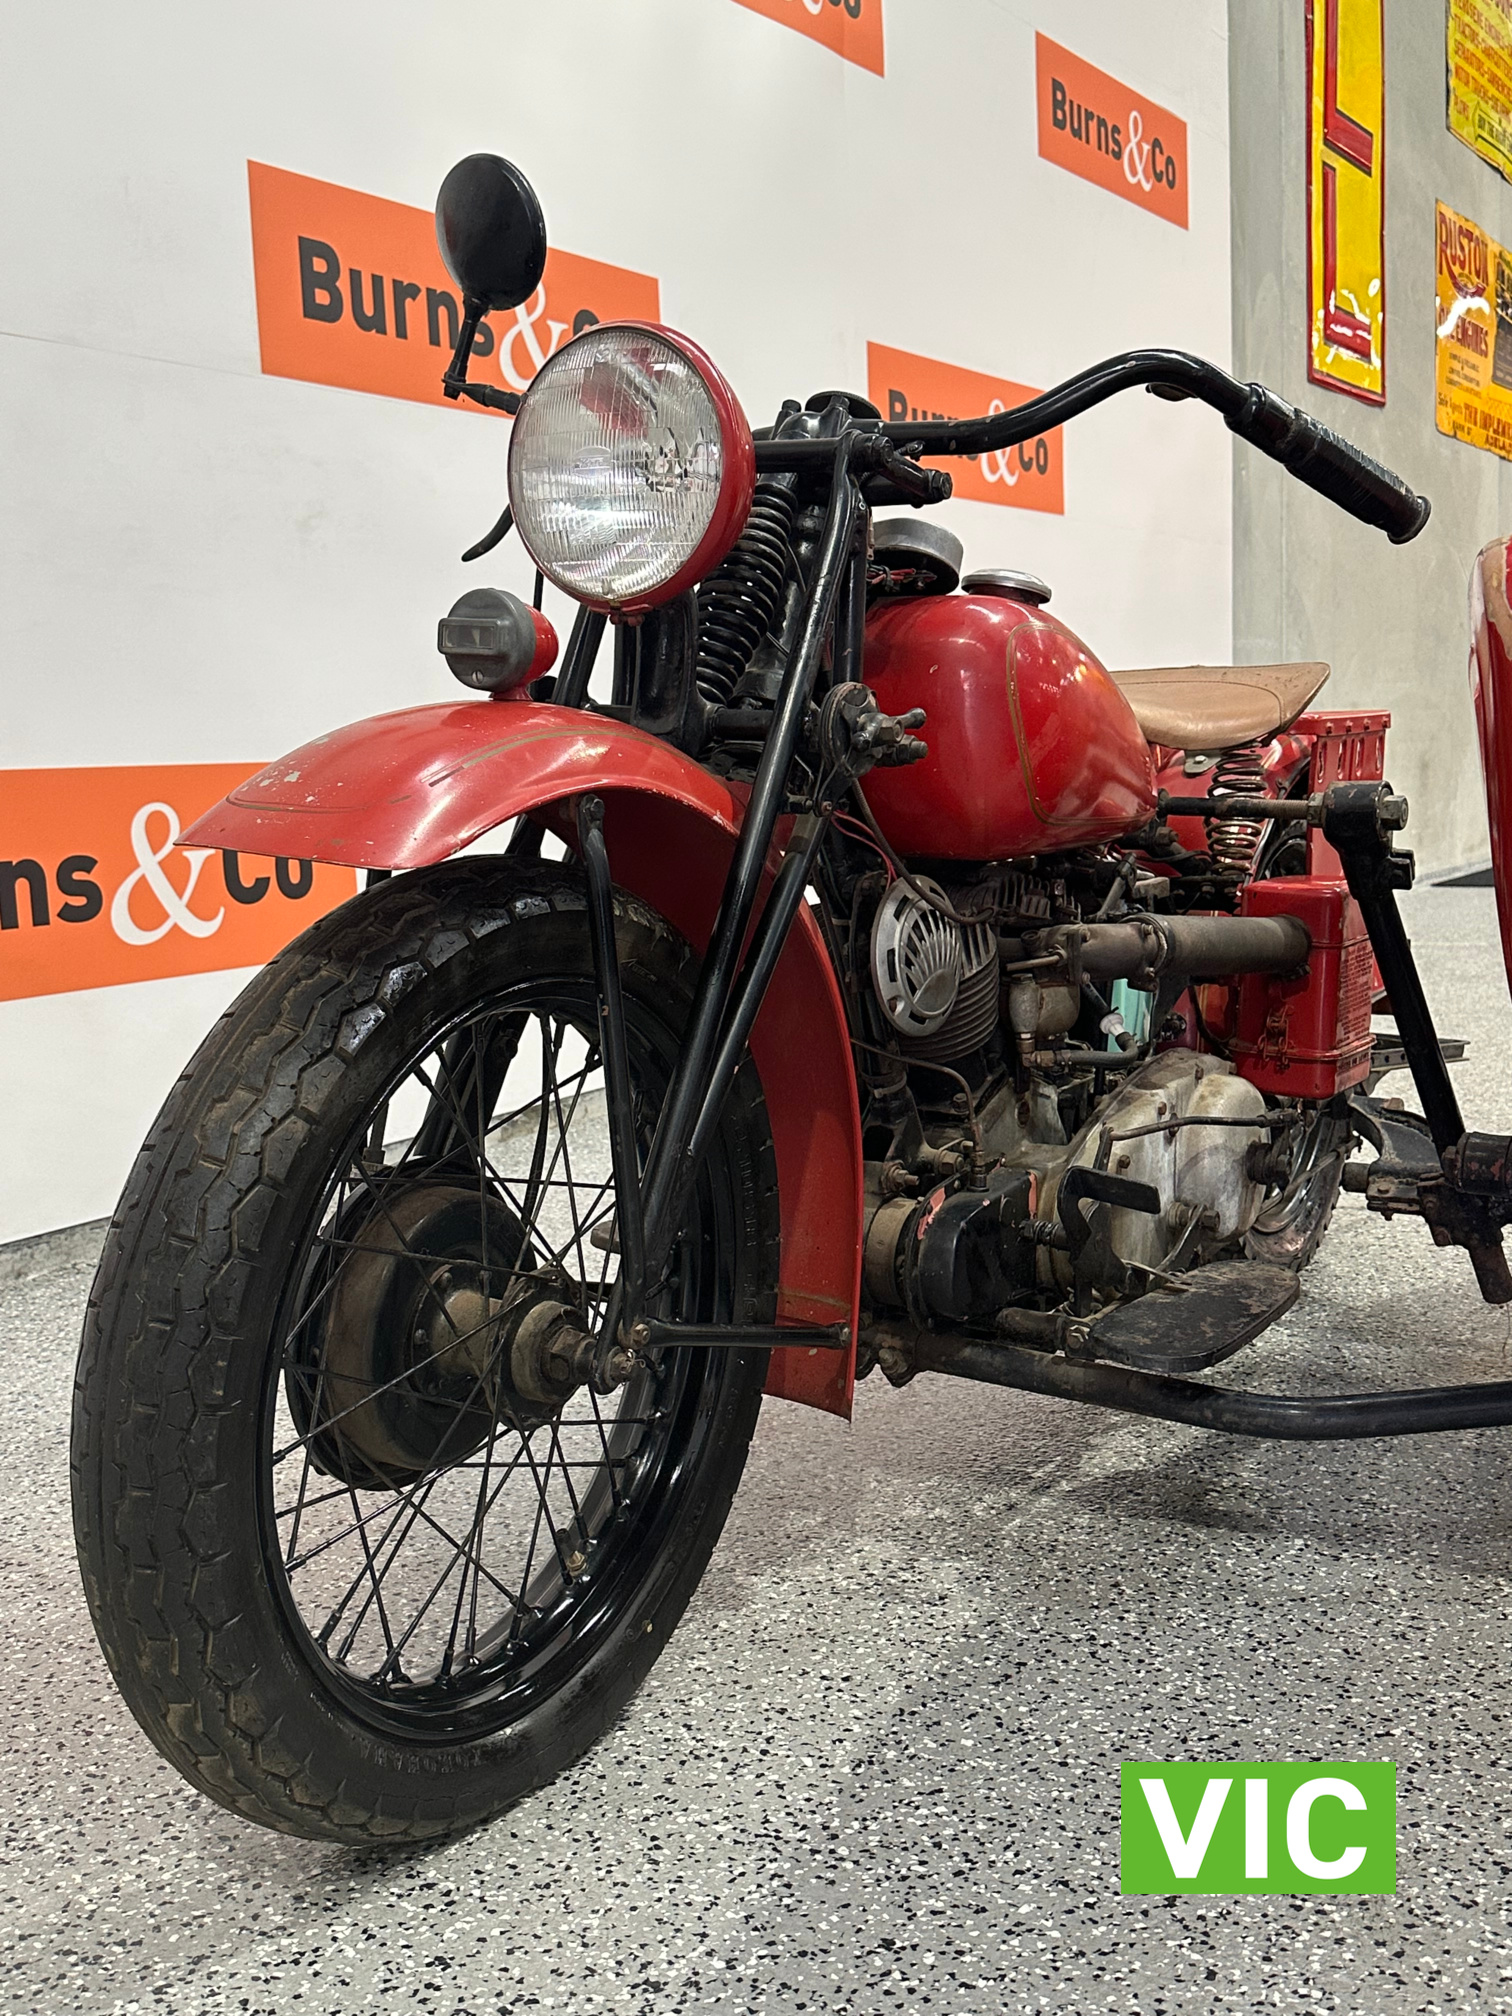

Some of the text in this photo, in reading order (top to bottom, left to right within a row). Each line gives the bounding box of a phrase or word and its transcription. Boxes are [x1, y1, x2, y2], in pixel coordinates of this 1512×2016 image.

[1051, 76, 1176, 192] Burns&Co
[1438, 210, 1489, 298] RUSTON
[298, 235, 600, 392] Burns&
